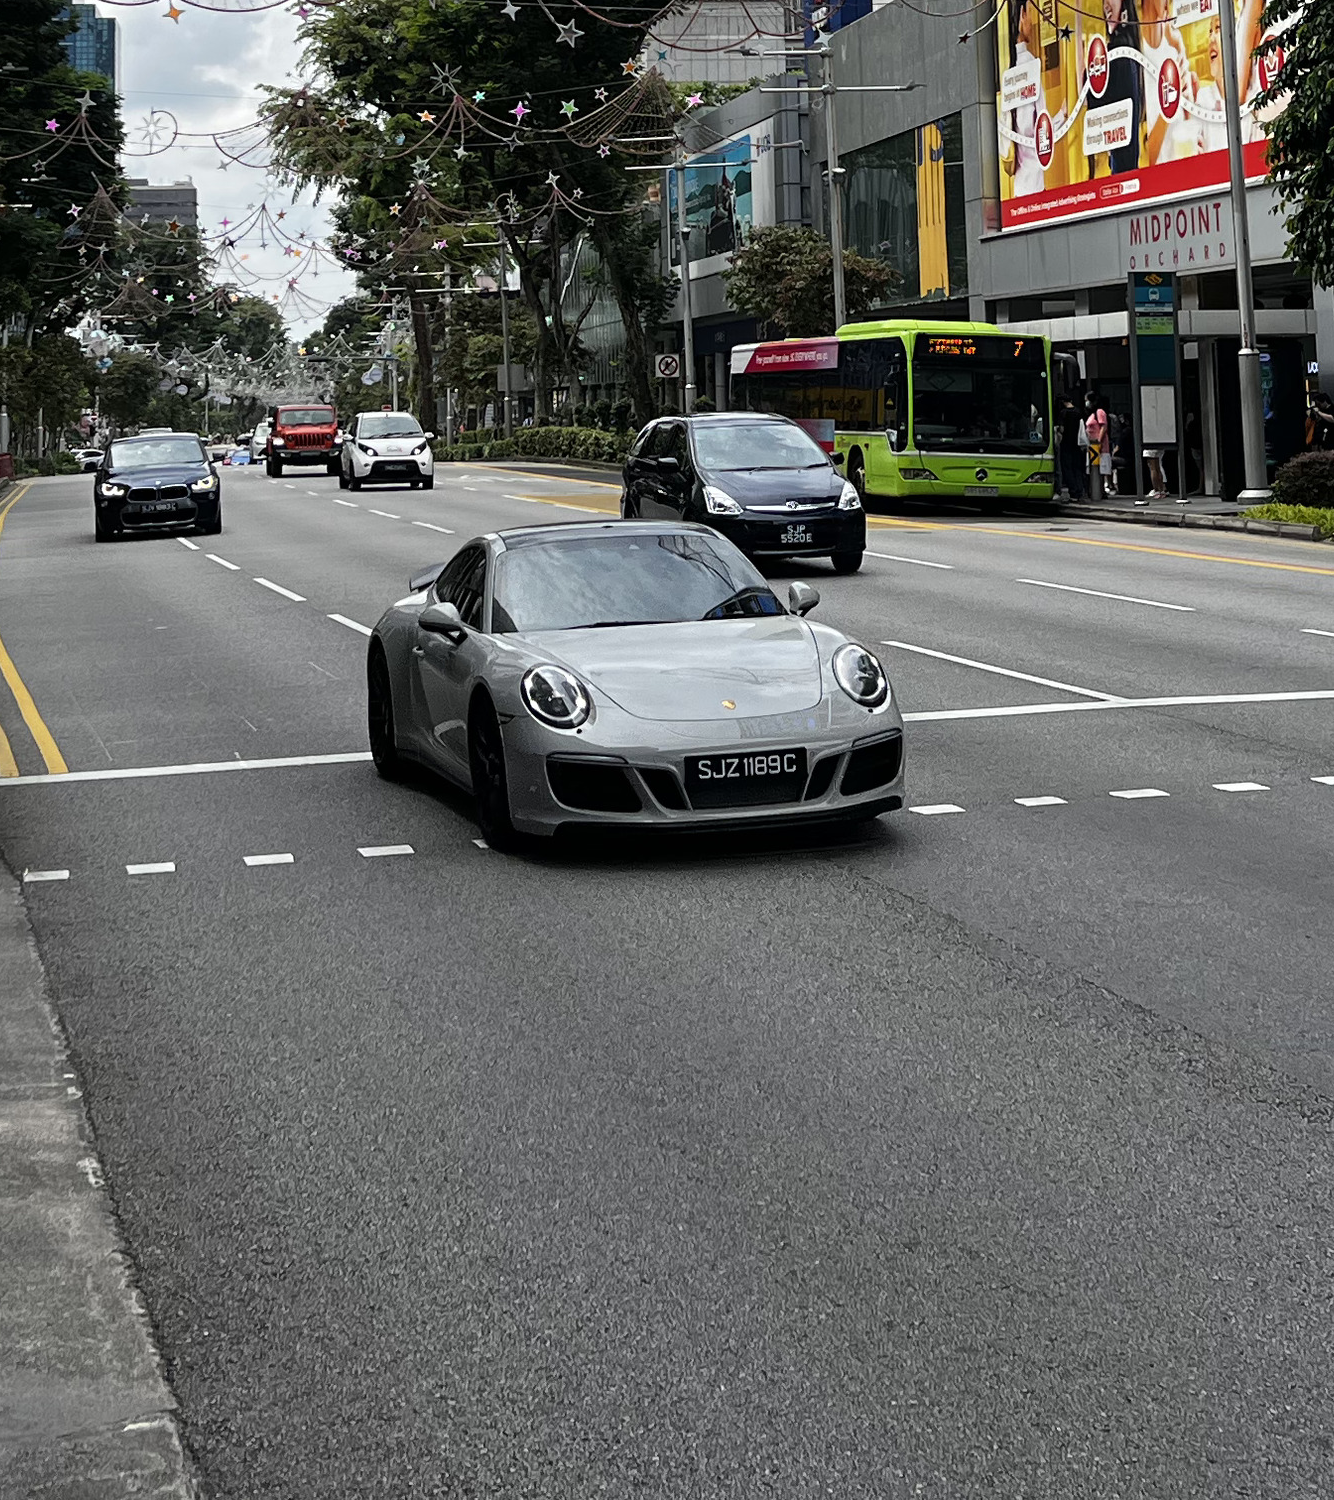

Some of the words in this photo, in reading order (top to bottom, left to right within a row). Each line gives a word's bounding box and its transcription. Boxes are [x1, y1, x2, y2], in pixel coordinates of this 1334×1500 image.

[1020, 82, 1037, 100] HOME
[1102, 108, 1129, 124] connections
[1103, 125, 1127, 146] TRAVEL
[1130, 203, 1221, 246] MIDPOINT
[1130, 242, 1226, 269] ORCHARD
[1013, 341, 1024, 357] 7
[787, 524, 806, 533] SJP
[698, 753, 797, 779] SJZ1189C
